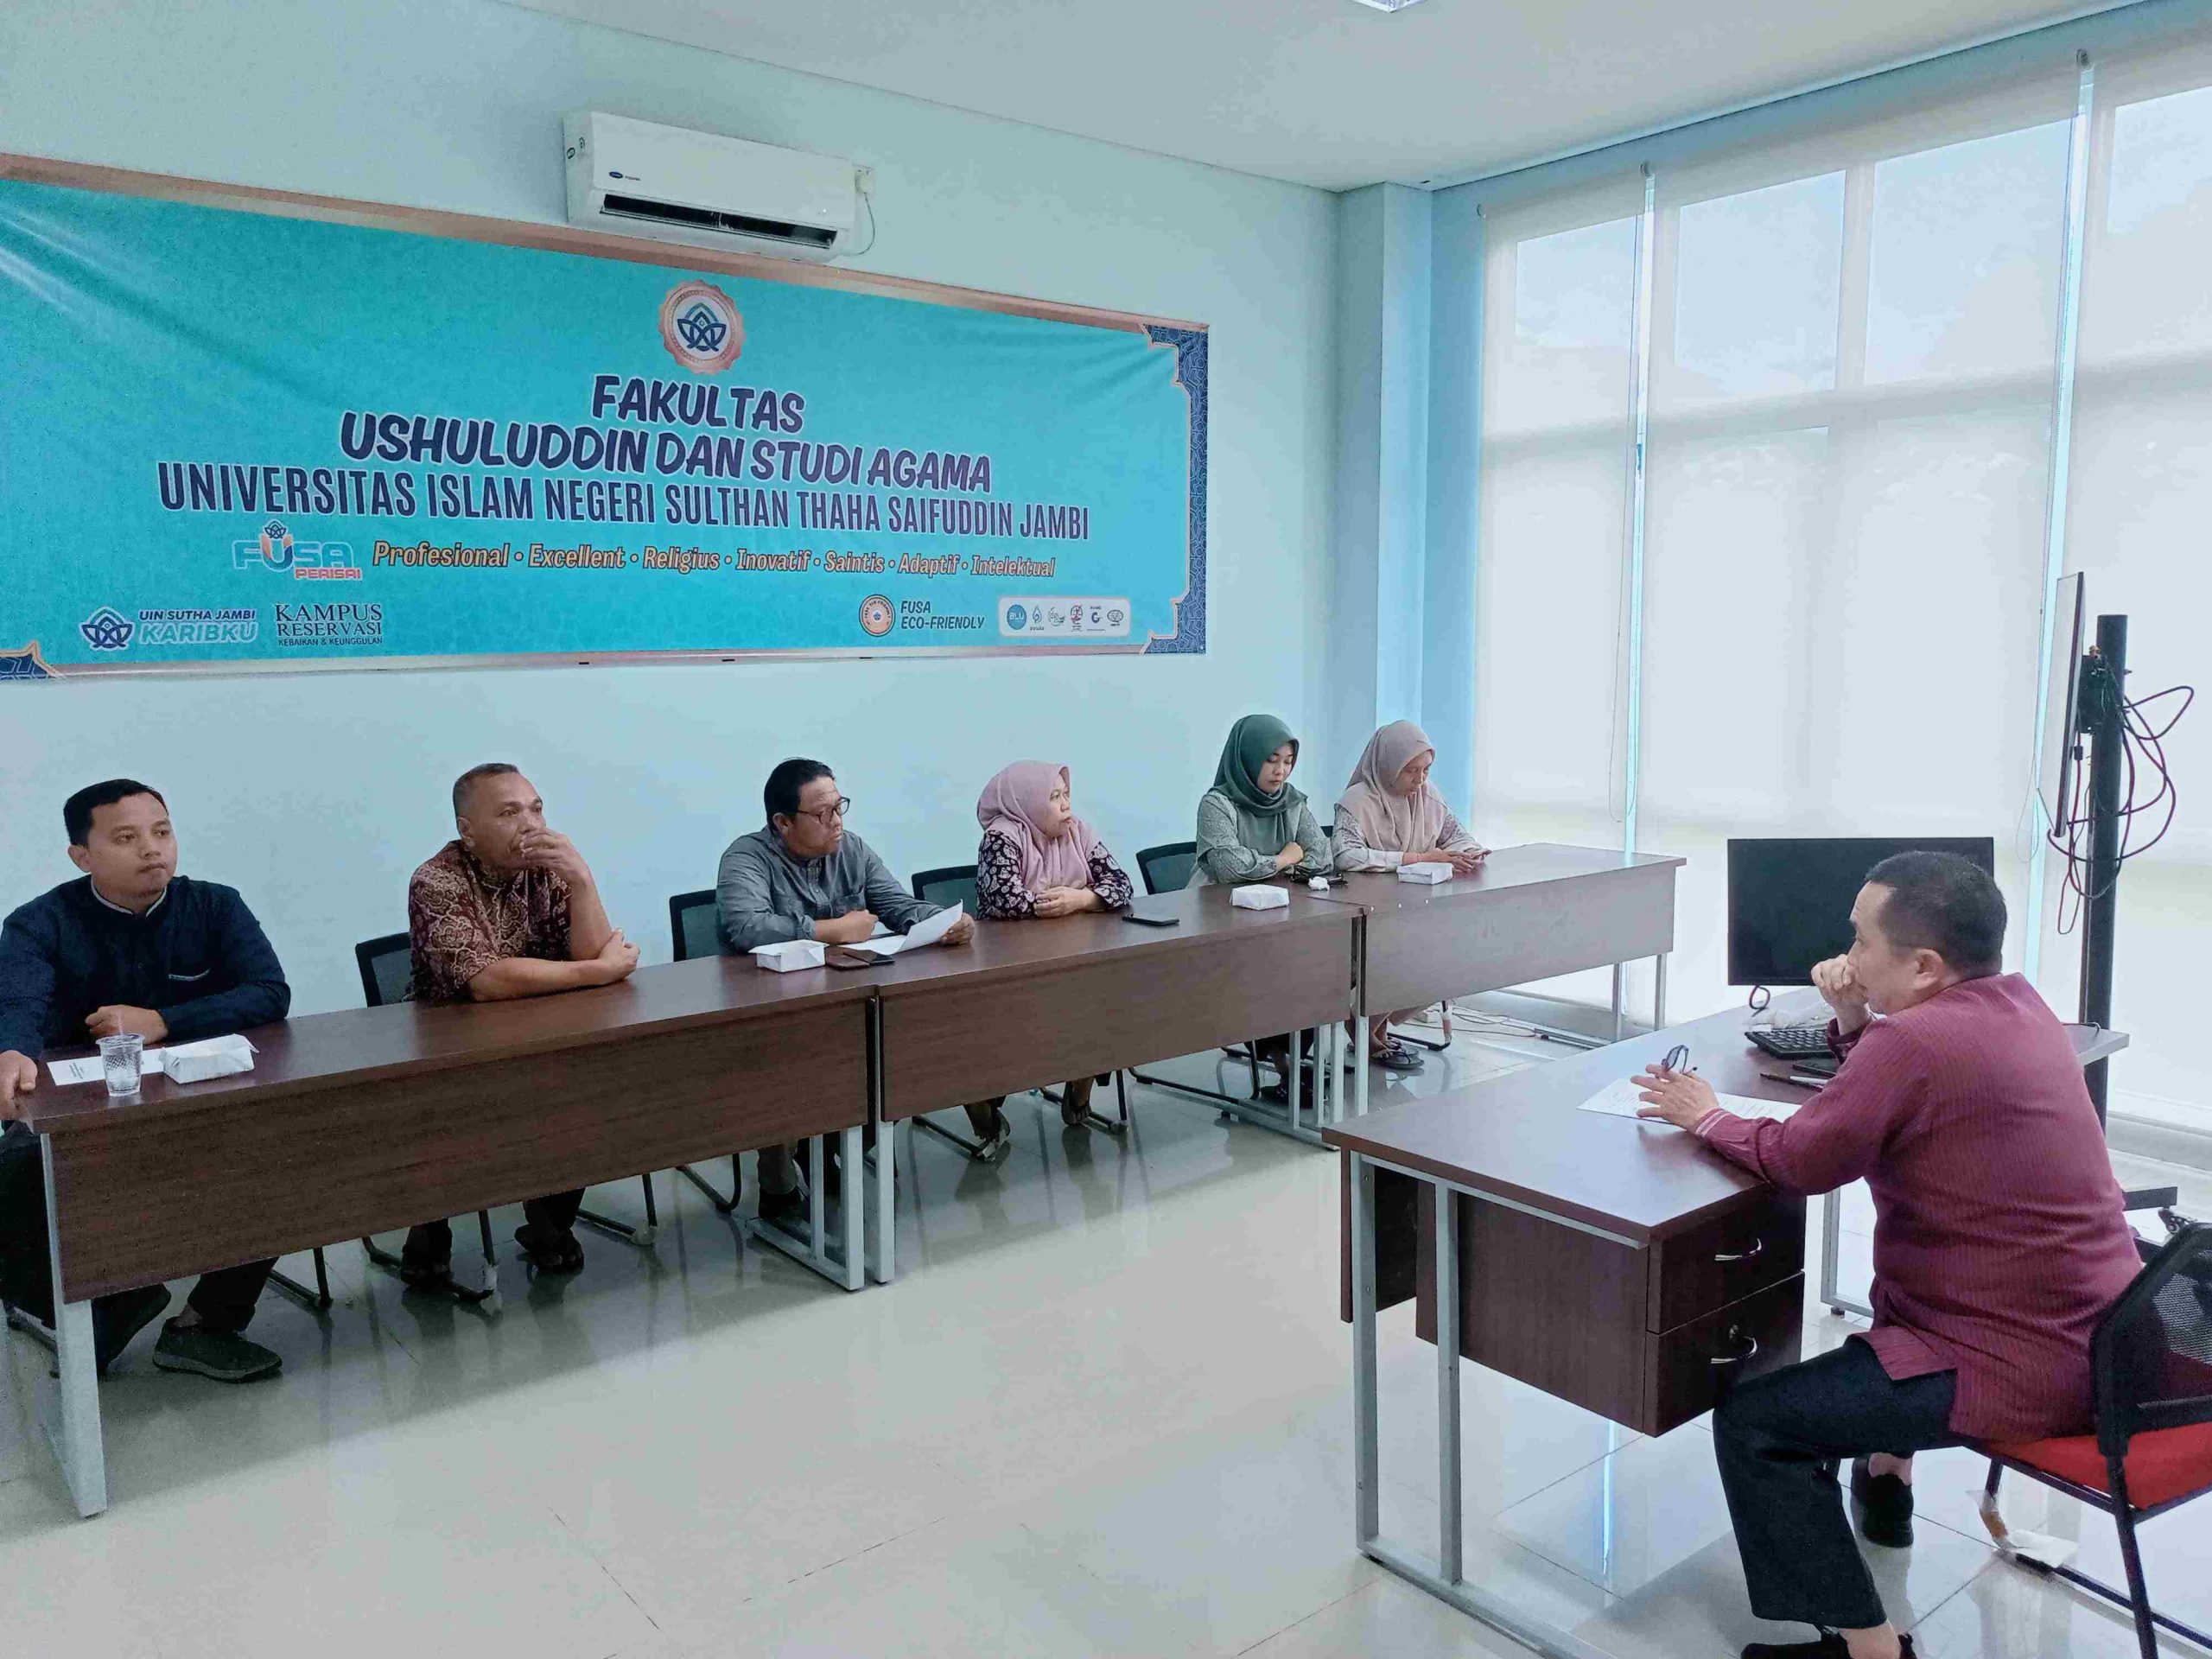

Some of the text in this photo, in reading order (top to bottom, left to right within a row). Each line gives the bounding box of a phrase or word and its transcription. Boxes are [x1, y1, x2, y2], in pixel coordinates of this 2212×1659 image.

[592, 375, 805, 432] FAKULTAS
[340, 412, 991, 493] USHULUDDIN DAN STUDI AGAMA
[158, 461, 1089, 541] UNIVERSITAS ISLAM NEGERI SULTHAN THAHA SAIFUDDIN JAMBI
[232, 533, 354, 572] FUSA
[372, 540, 1056, 579] Profesional Excellent Religius Inovatif Saintis Adaptif Intelektual
[139, 609, 256, 621] UIN SUTHA JAMBI
[276, 604, 383, 621] KAMPUS
[900, 601, 931, 614] FUSA
[276, 622, 383, 637] RESERVASI
[901, 615, 985, 629] ECO-FRIENDLY
[139, 623, 257, 645] KARIBKU
[278, 638, 318, 647] KEBAIKAN
[329, 638, 383, 646] KEUNGGULAN
